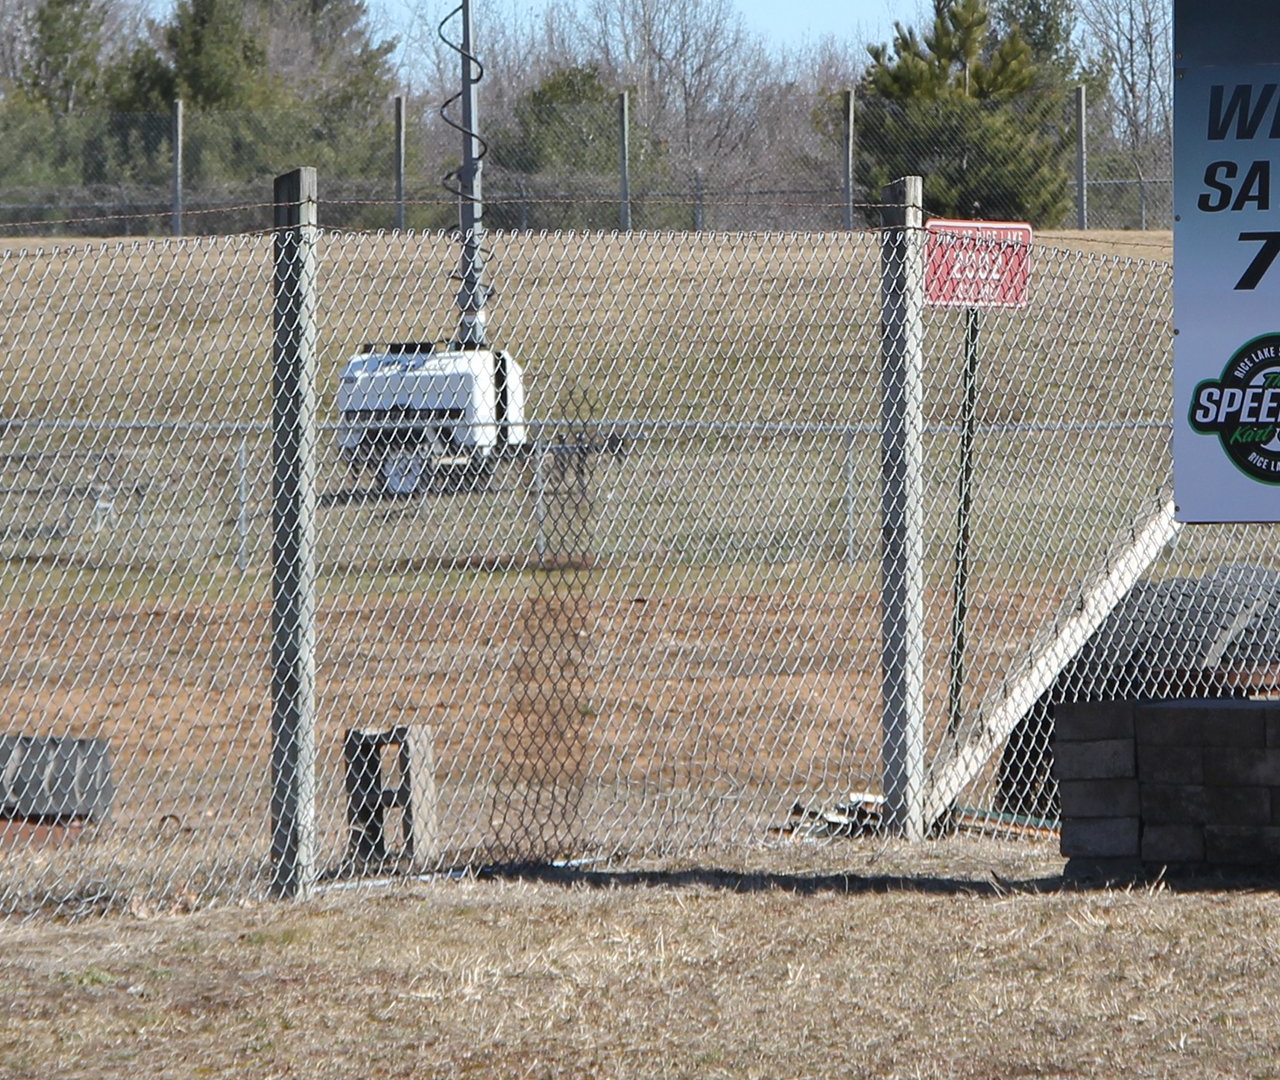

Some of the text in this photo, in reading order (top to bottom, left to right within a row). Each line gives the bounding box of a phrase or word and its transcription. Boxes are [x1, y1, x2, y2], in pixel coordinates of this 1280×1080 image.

[1233, 357, 1254, 380] RICE
[1251, 346, 1276, 363] LAKE
[1230, 424, 1275, 445] Kart
[1247, 452, 1268, 469] RICE
